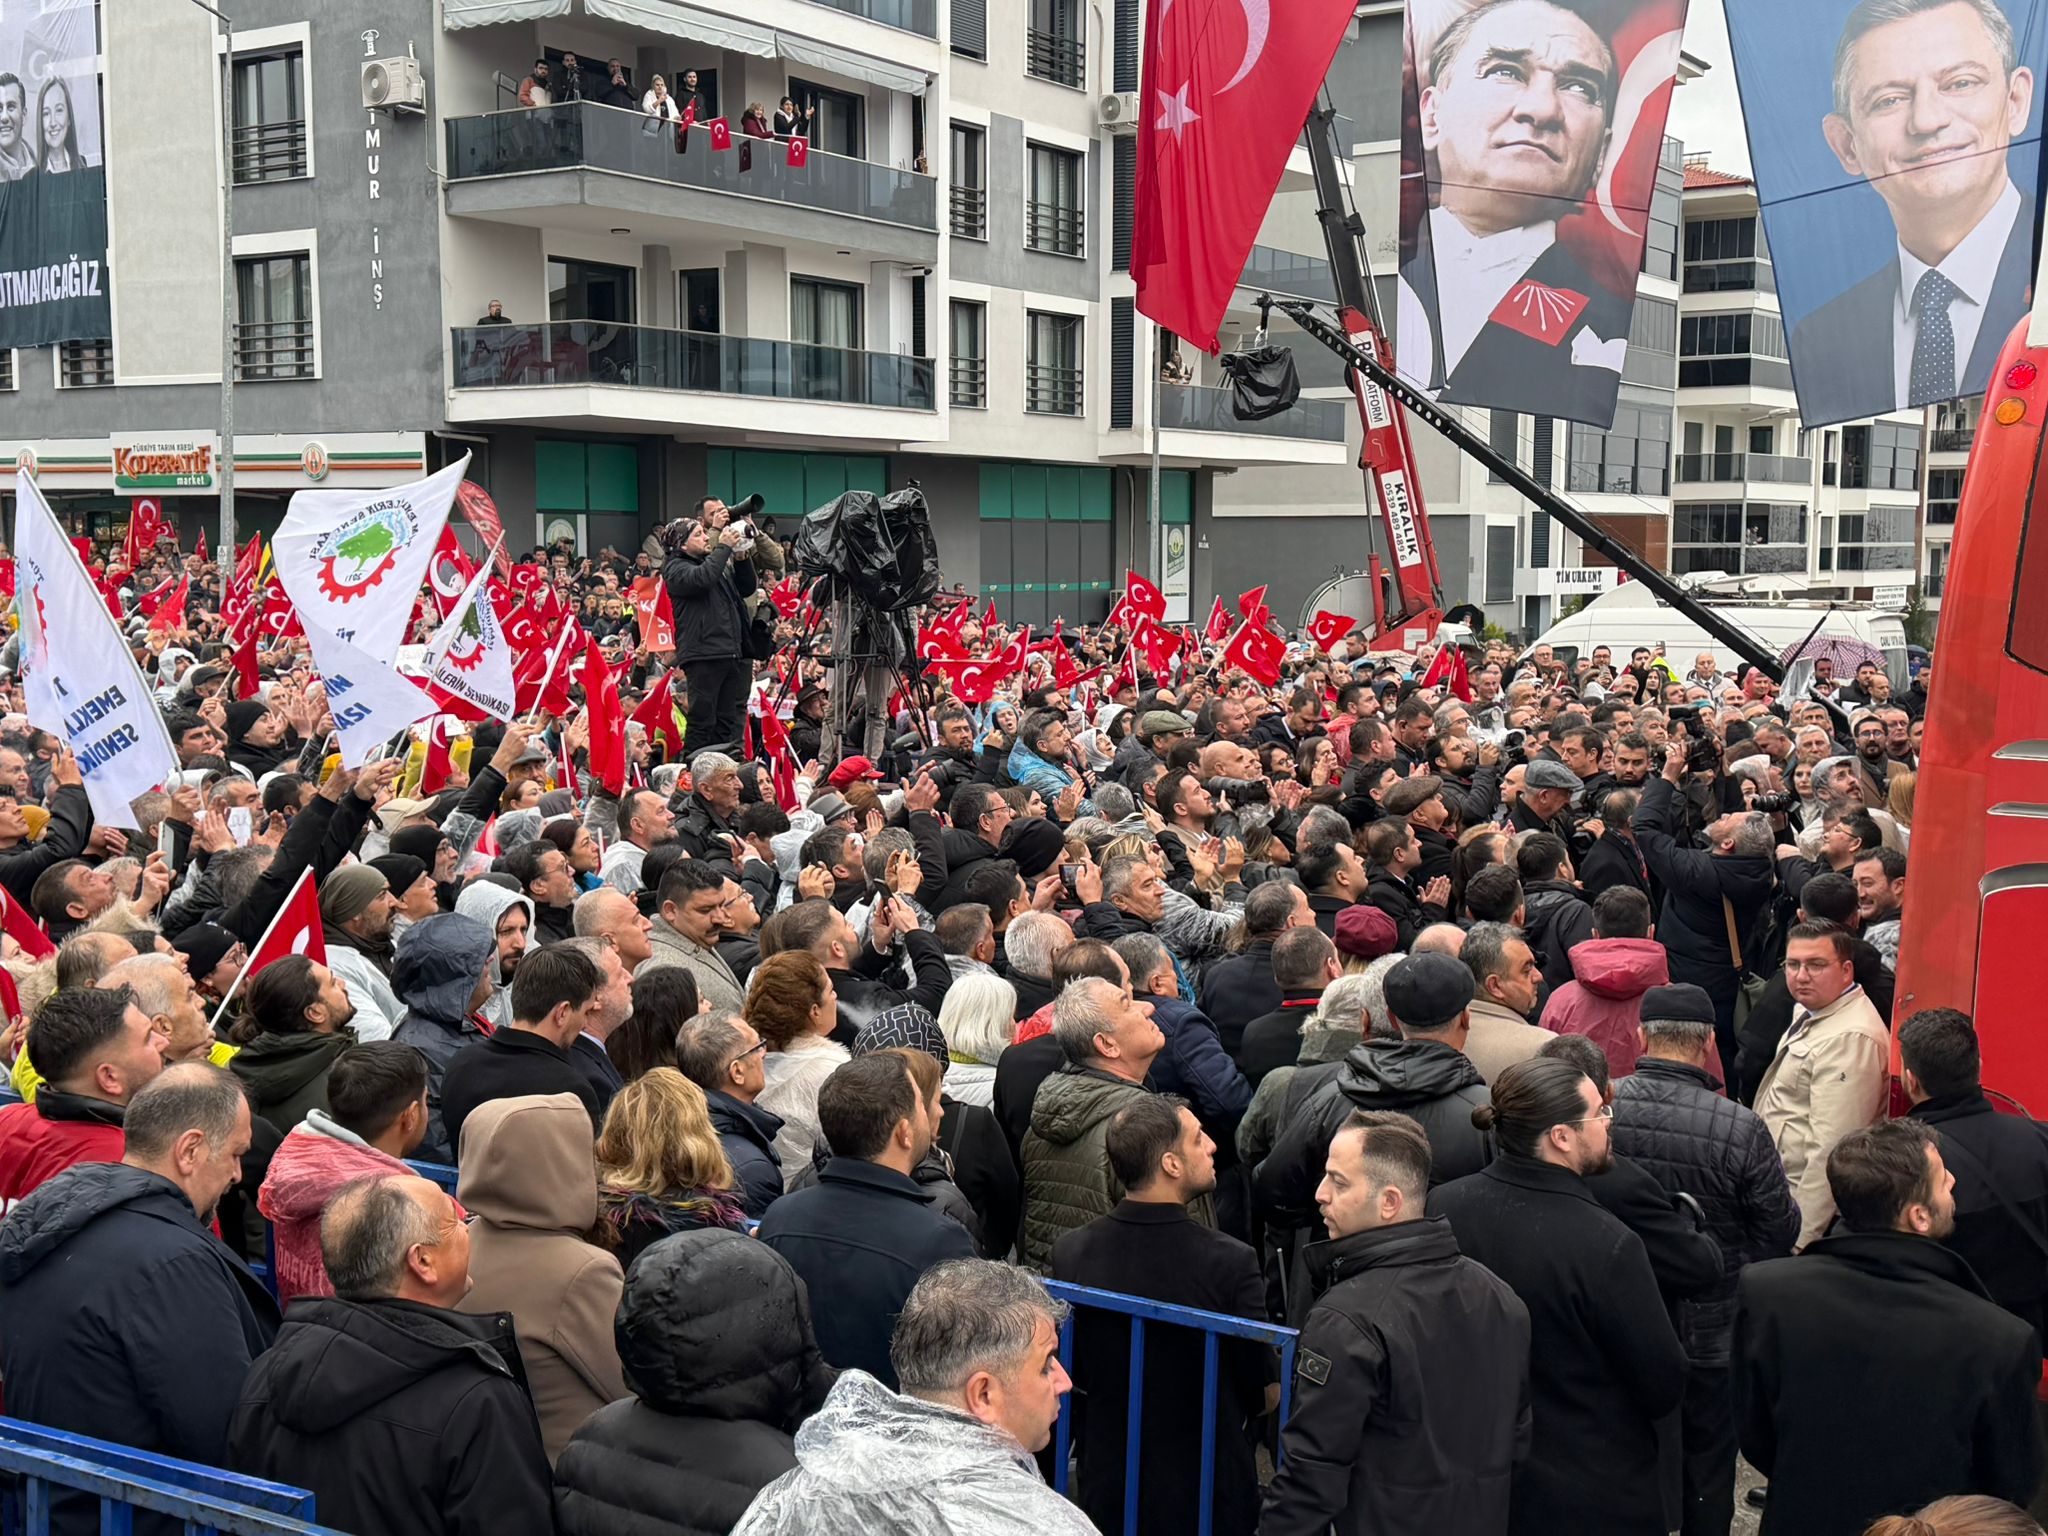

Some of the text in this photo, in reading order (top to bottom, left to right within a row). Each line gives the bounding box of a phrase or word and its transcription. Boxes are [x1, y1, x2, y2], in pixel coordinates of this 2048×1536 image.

[1366, 379, 1383, 422] LATFORM
[176, 475, 205, 486] market
[1395, 483, 1418, 556] KİRALIK
